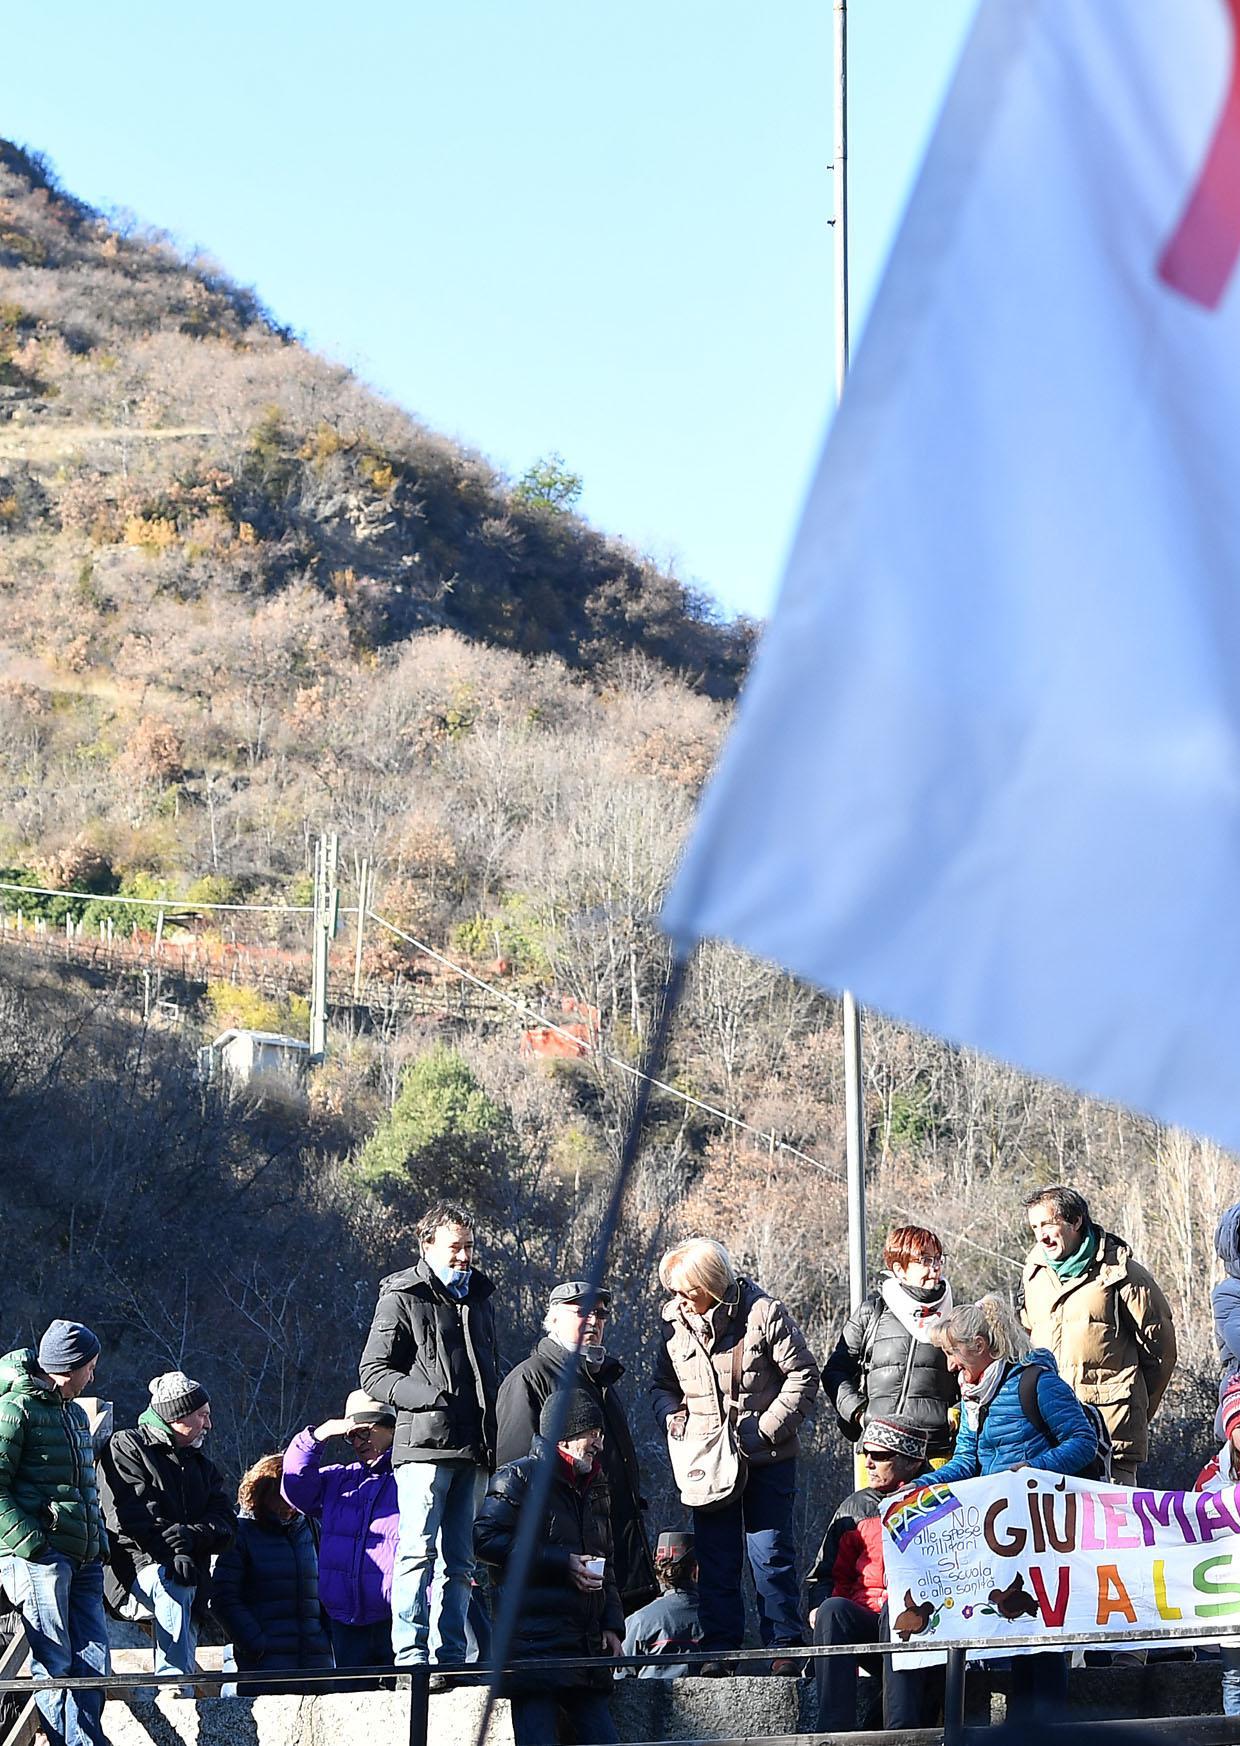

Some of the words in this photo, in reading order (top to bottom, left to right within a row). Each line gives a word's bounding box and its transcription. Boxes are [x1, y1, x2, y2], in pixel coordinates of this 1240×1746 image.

[887, 1483, 952, 1541] PACE
[952, 1505, 980, 1531] NO
[917, 1570, 942, 1587] alla
